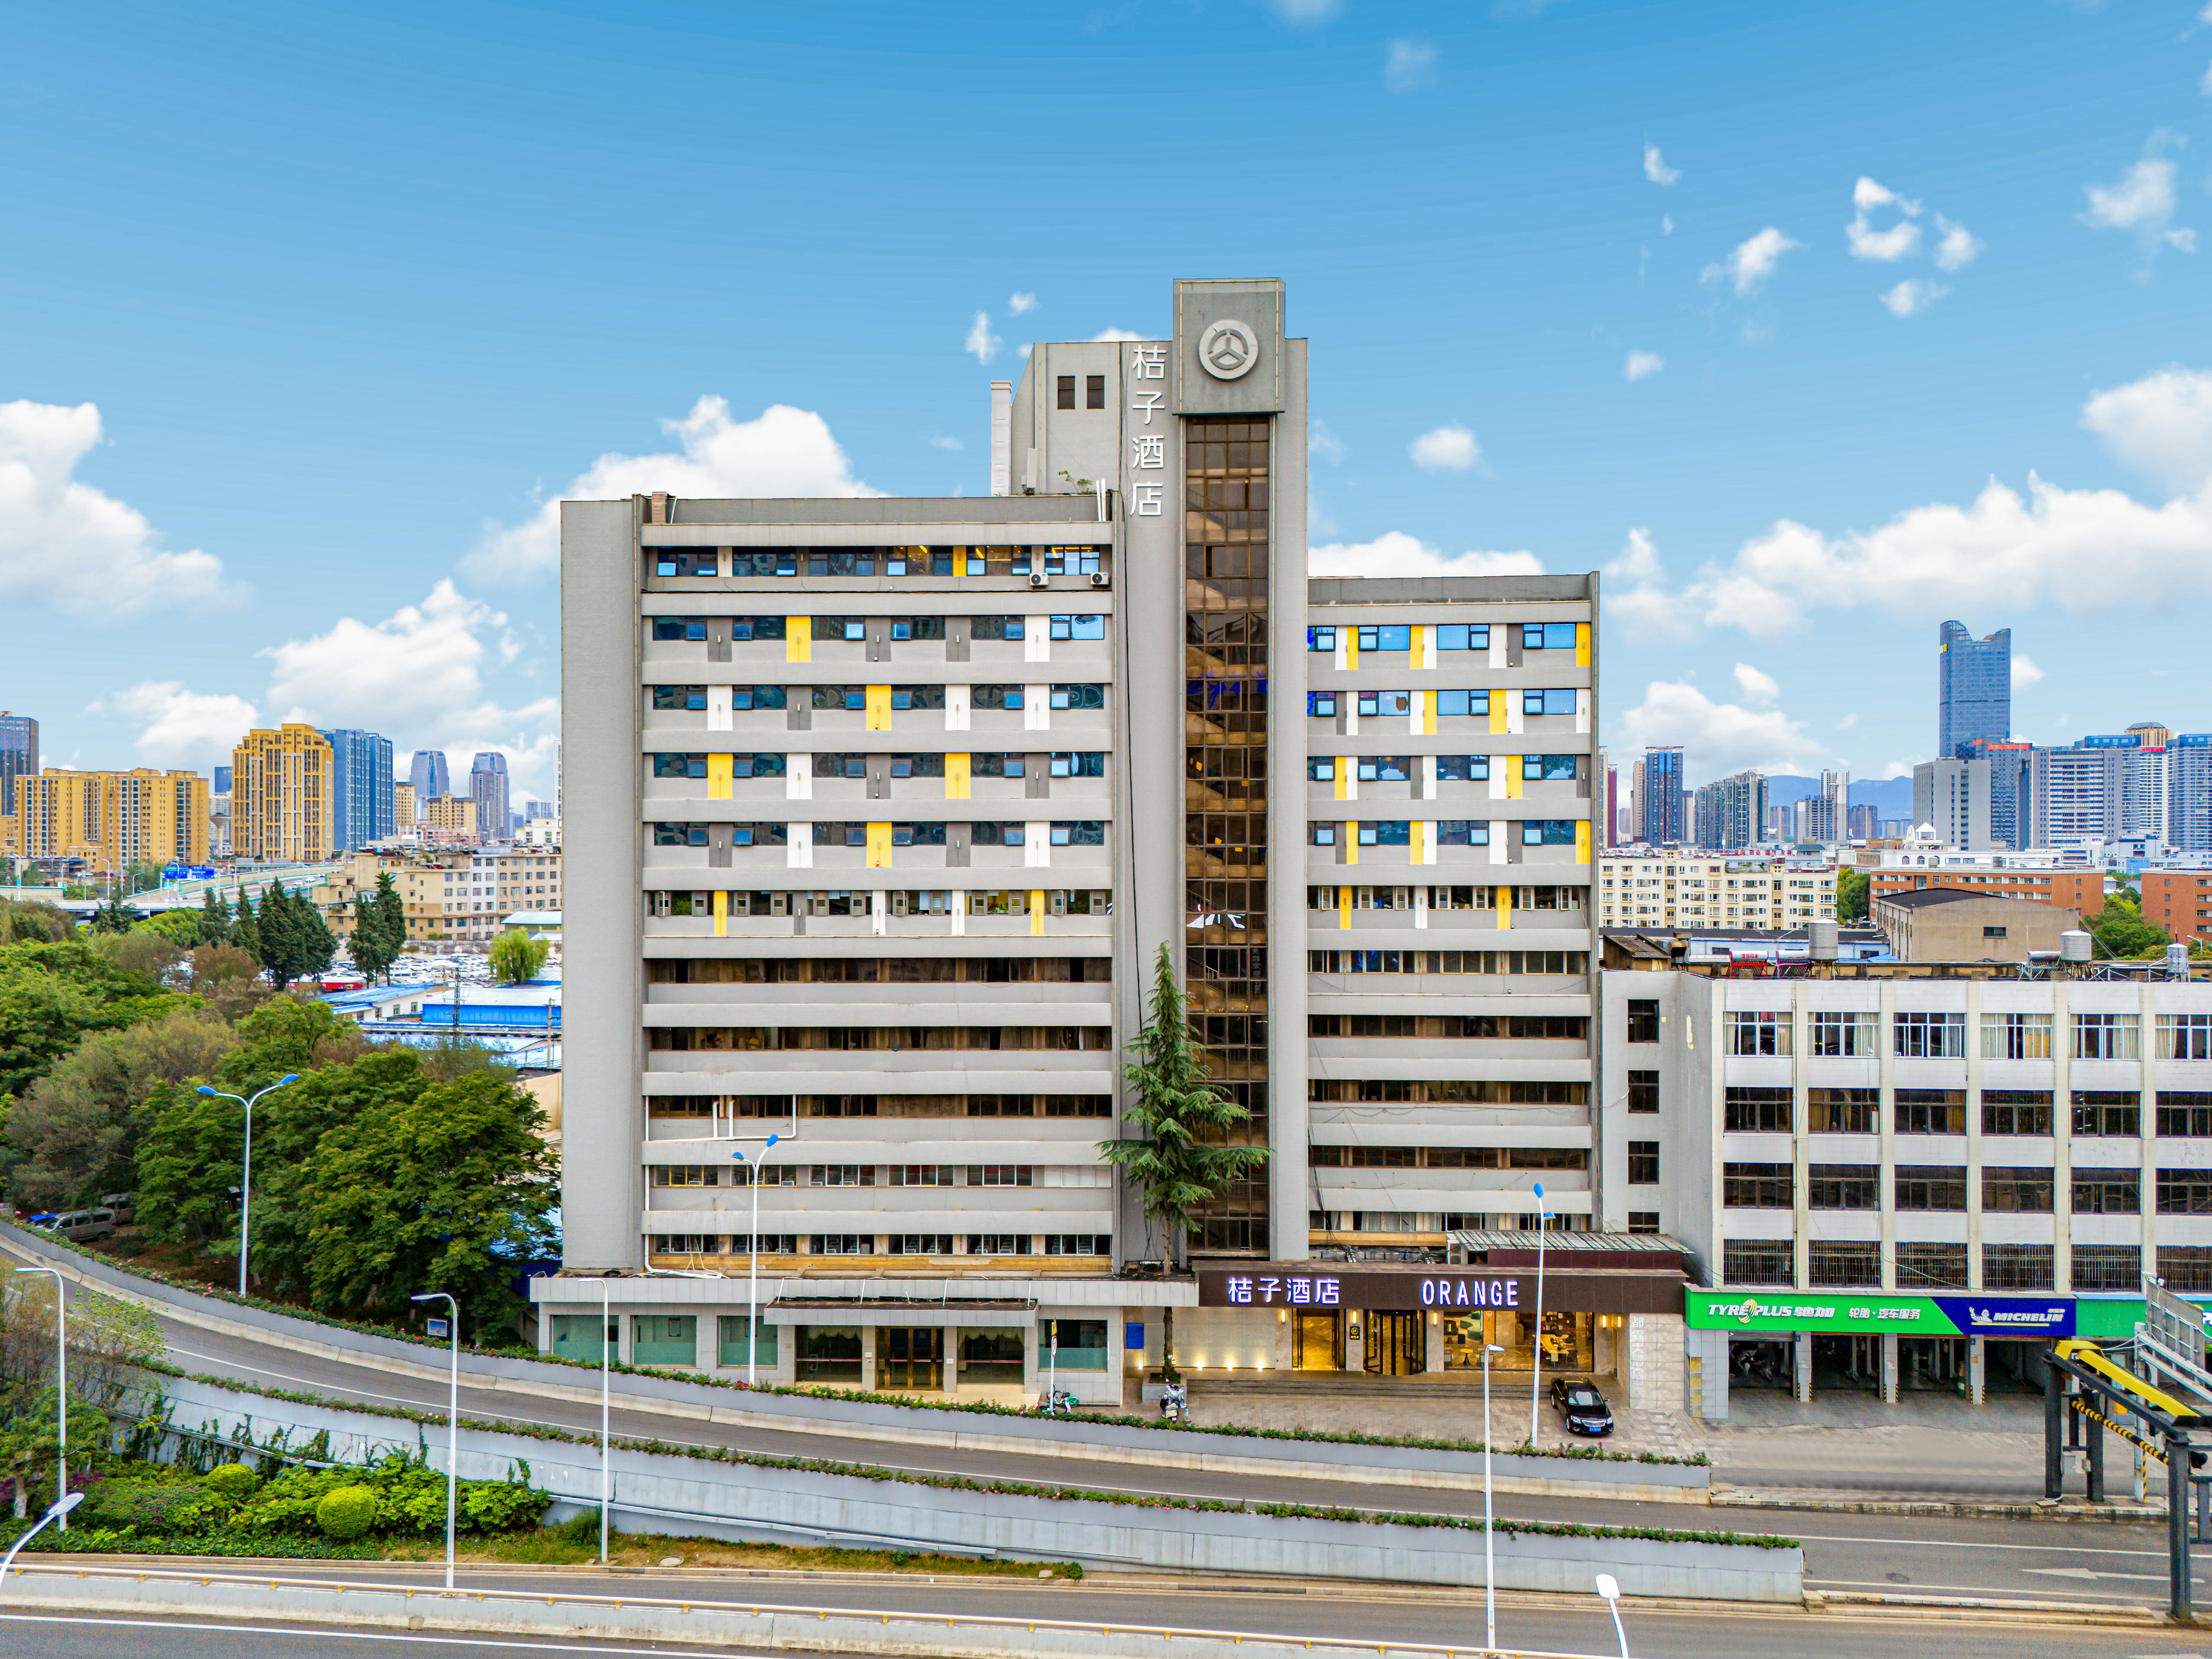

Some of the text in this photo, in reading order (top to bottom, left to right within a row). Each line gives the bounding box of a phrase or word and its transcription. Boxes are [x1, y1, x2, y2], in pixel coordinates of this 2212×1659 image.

[1130, 345, 1166, 516] 桔子酒店
[1227, 1277, 1340, 1304] 桔子酒店
[1422, 1280, 1518, 1307] ORANGE
[1794, 1306, 1835, 1318] 驰加
[1993, 1312, 2064, 1322] MICHELIN
